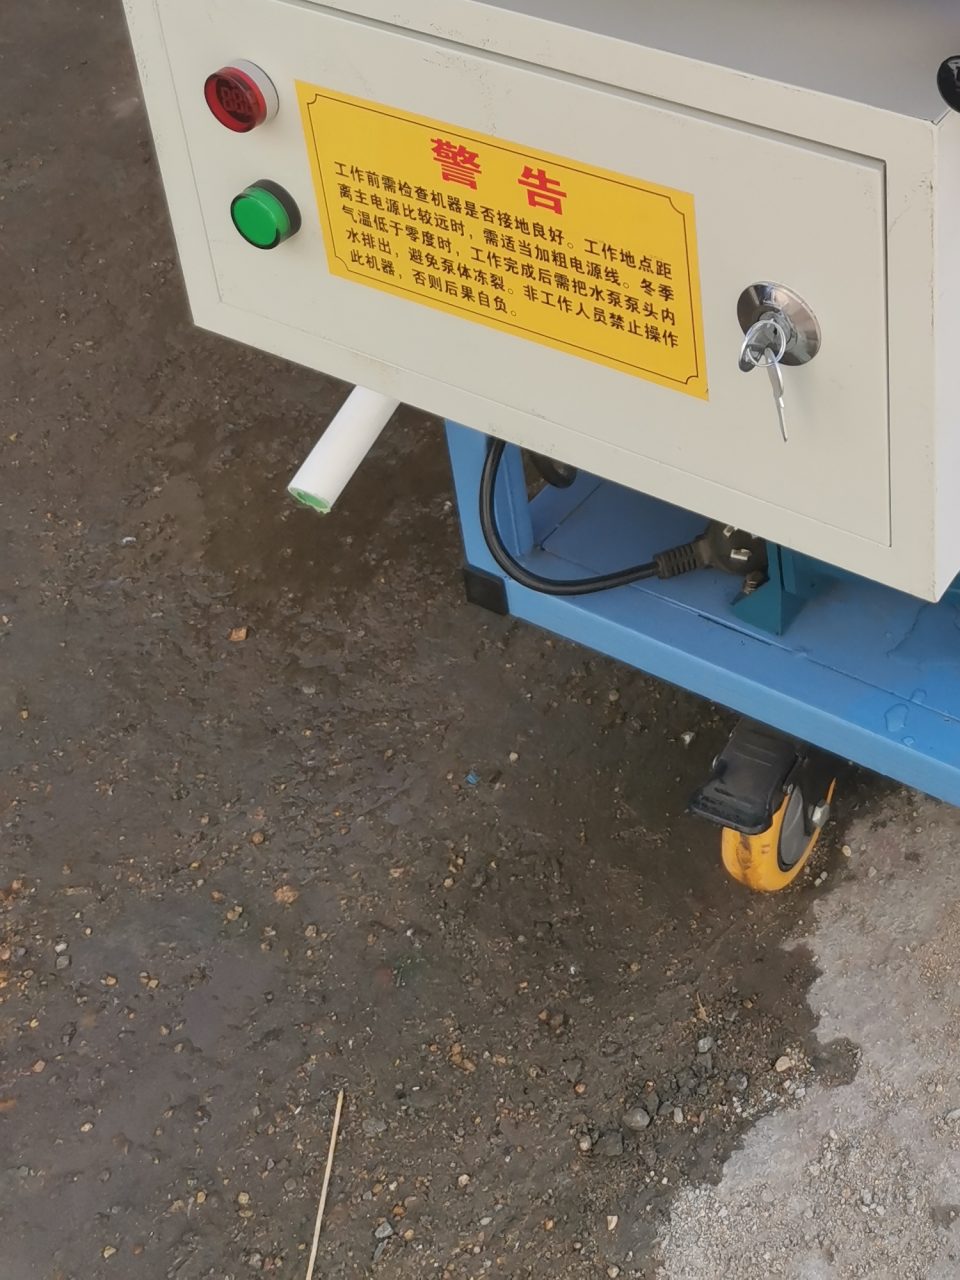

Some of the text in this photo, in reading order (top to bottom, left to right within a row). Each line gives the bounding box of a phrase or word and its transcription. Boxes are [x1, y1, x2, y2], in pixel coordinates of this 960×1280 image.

[430, 137, 567, 215] 警告
[334, 161, 673, 280] 工作前需检查机器是否接地良好。工作地点距
[350, 249, 517, 317] 此机器，否则后果自负。
